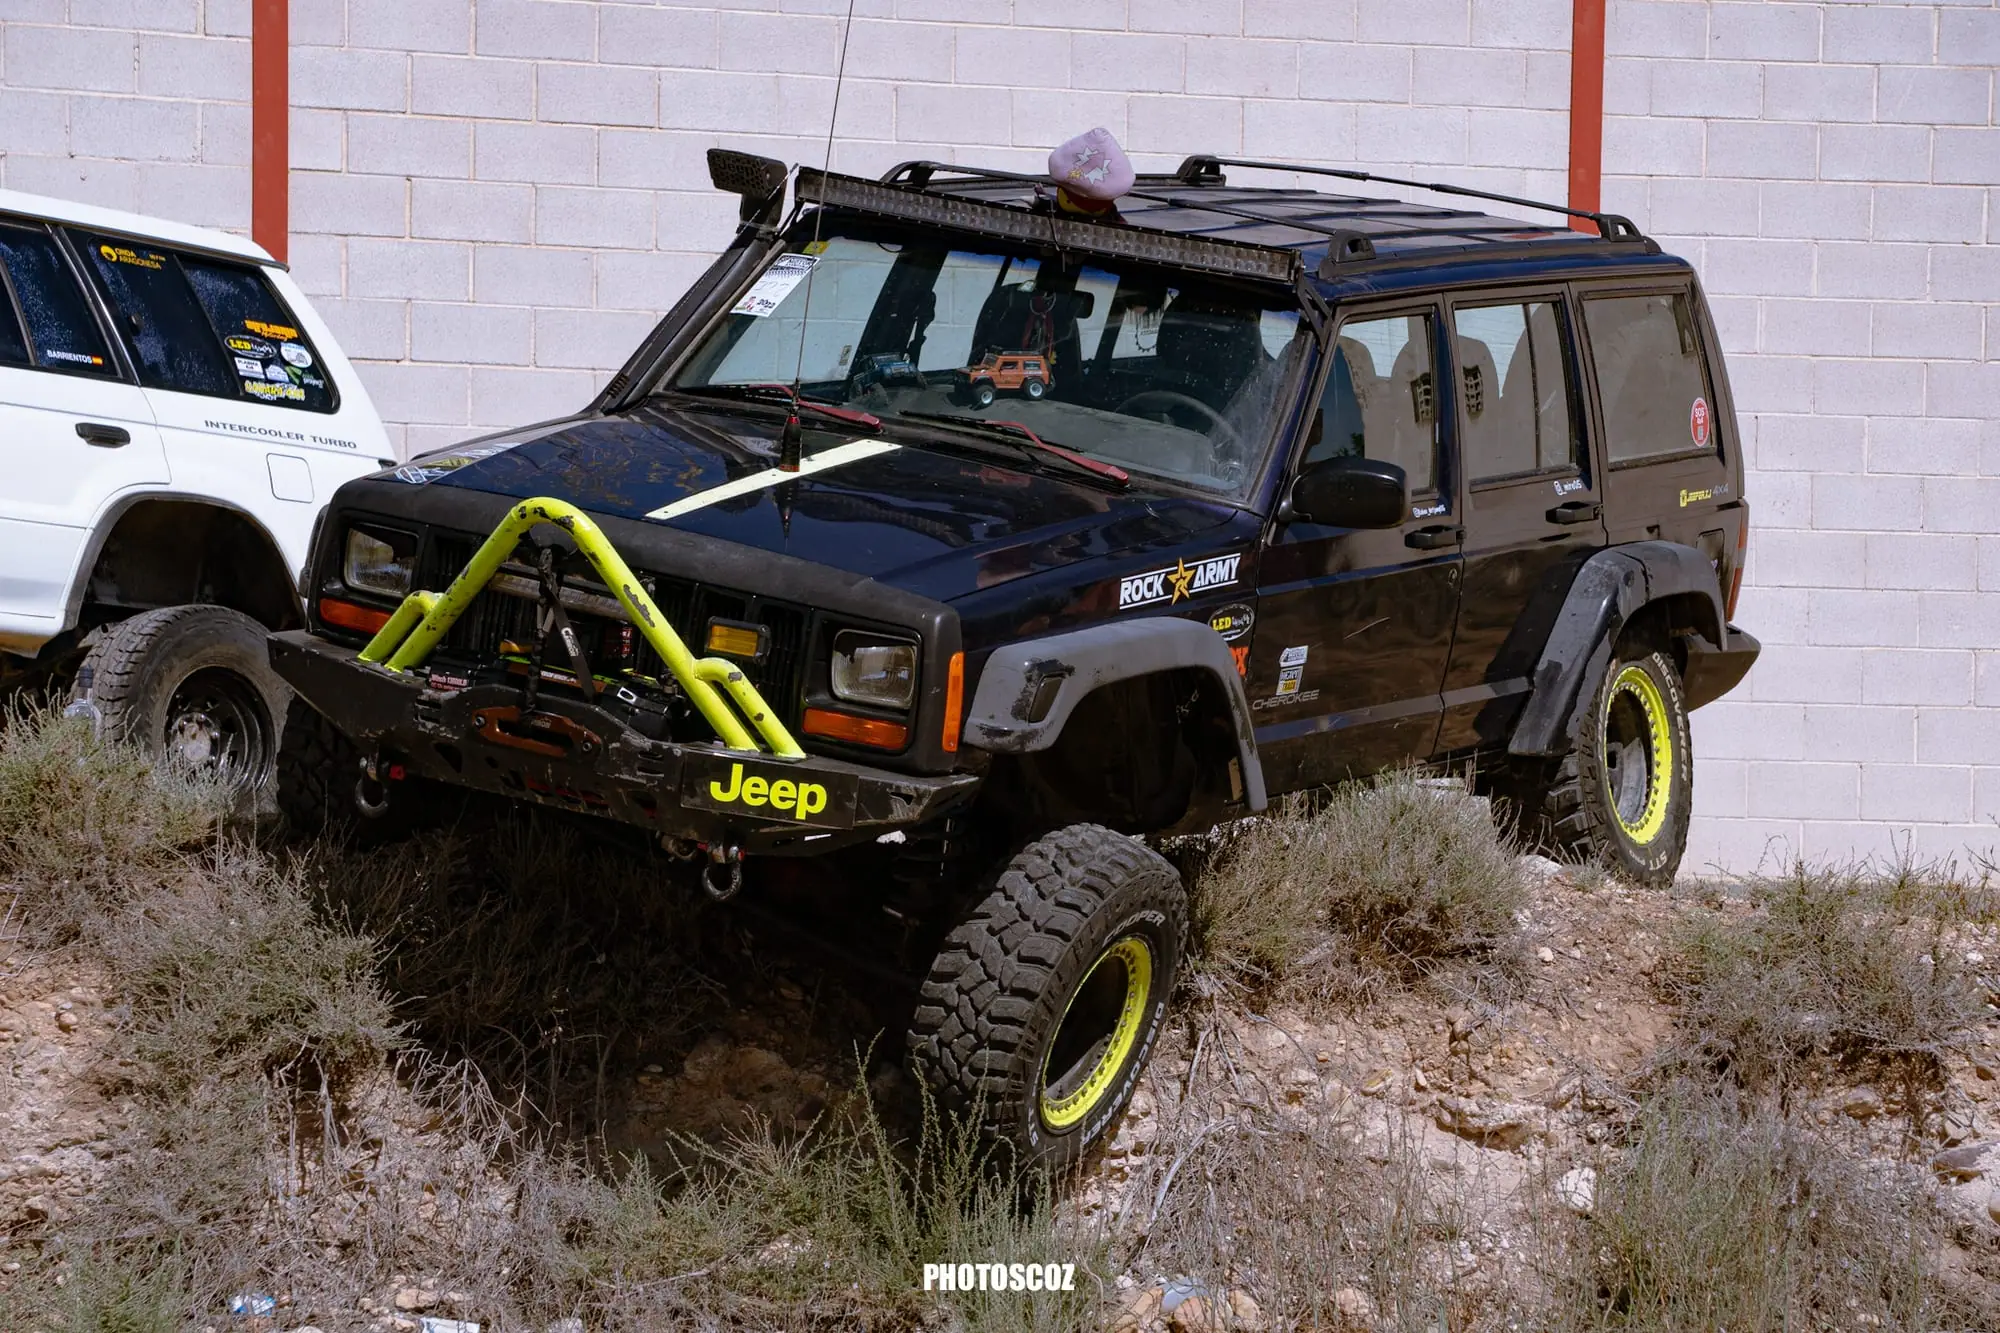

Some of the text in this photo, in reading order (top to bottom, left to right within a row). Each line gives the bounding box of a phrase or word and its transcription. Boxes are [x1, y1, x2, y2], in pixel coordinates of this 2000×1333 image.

[46, 349, 93, 364] BARRIENTOS
[228, 338, 252, 351] LED
[204, 420, 358, 449] INTERCOOLER TURBO
[1120, 572, 1166, 605] ROCK
[1192, 556, 1241, 588] ARMY
[1212, 616, 1232, 631] LED
[1252, 688, 1321, 711] CHEROKEE
[1651, 651, 1689, 782] DISCOVERER
[709, 763, 828, 821] Jeep
[1648, 849, 1668, 871] STT
[1103, 909, 1167, 946] COOPER
[1081, 1001, 1165, 1146] DISCOVERER
